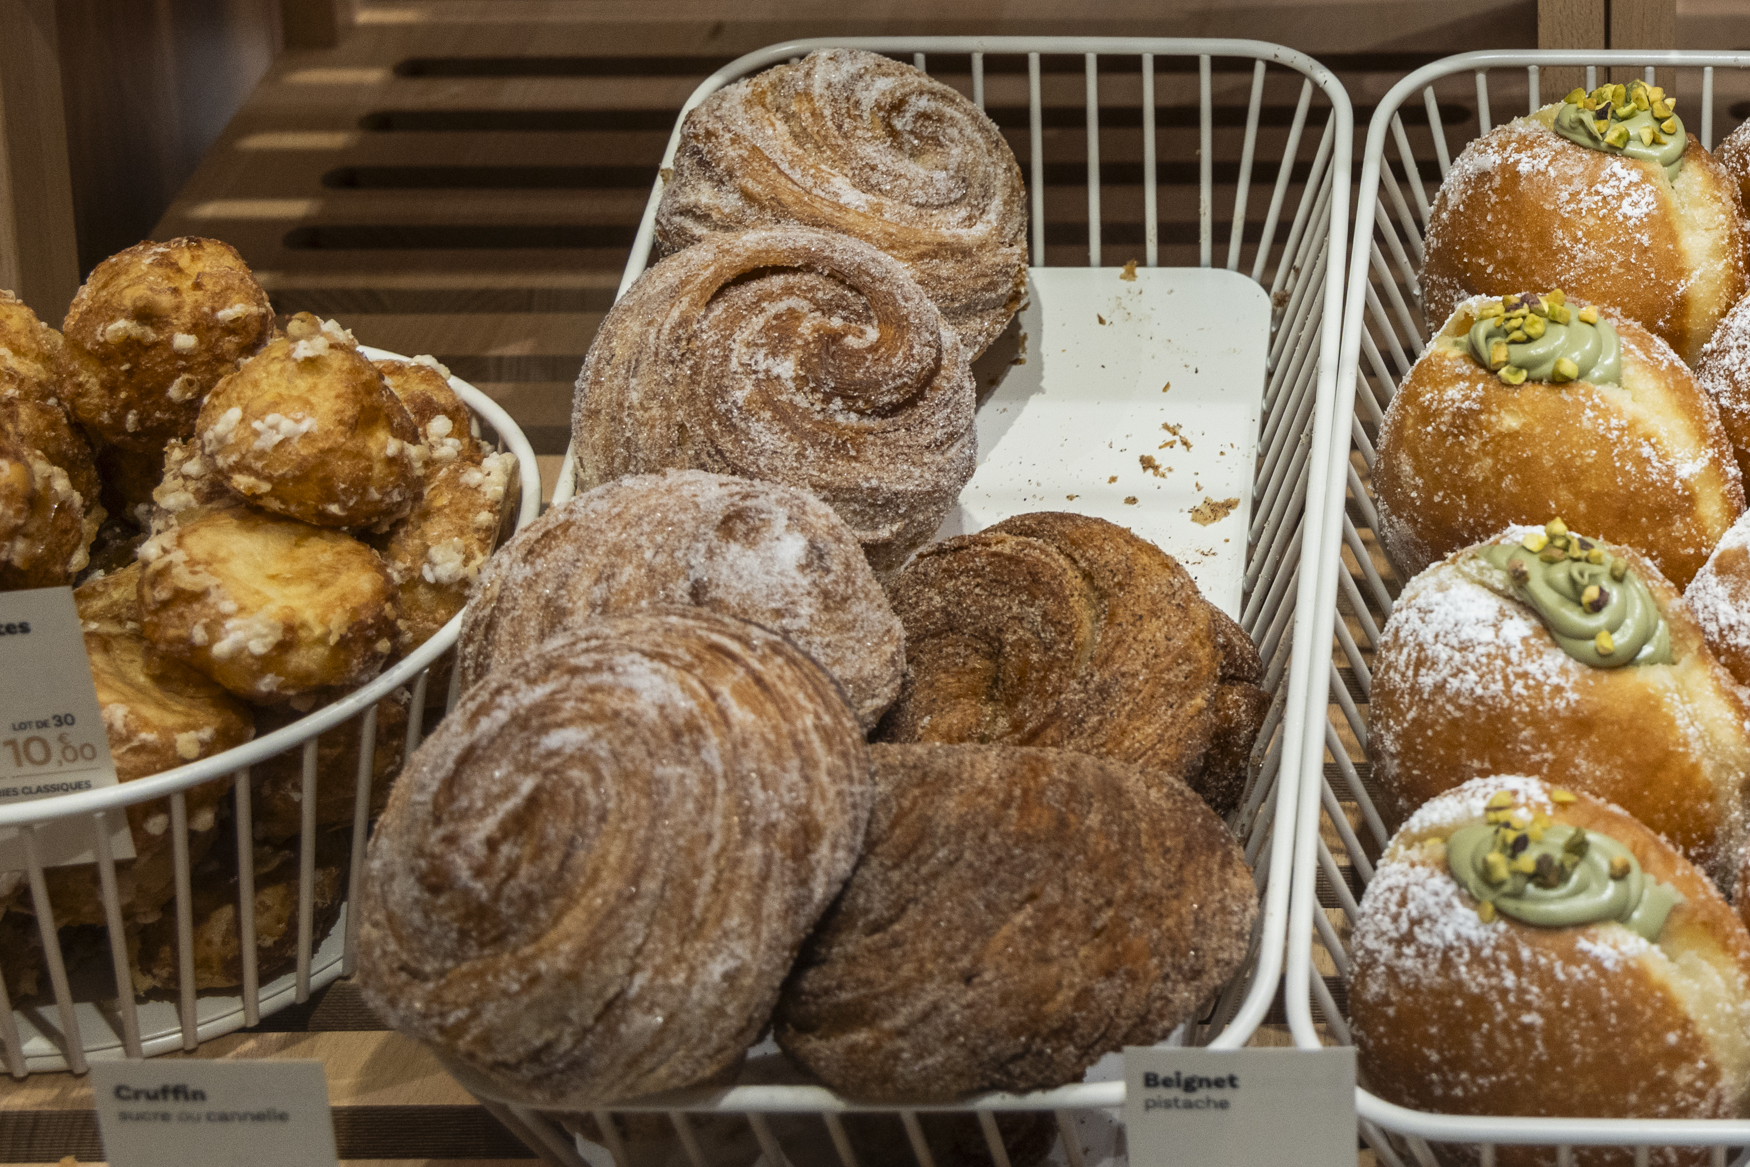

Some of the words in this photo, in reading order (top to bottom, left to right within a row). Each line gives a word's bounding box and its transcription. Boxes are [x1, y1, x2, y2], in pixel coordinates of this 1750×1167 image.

[12, 720, 33, 732] LOT
[36, 719, 50, 729] DE
[52, 713, 76, 728] 30
[21, 780, 92, 795] CLASSIQUES
[1143, 1071, 1240, 1093] Beignet
[113, 1083, 207, 1102] Cruffin
[1144, 1095, 1230, 1111] pistache
[118, 1110, 171, 1123] sucre
[177, 1111, 201, 1123] ou
[206, 1107, 289, 1123] cannelle
